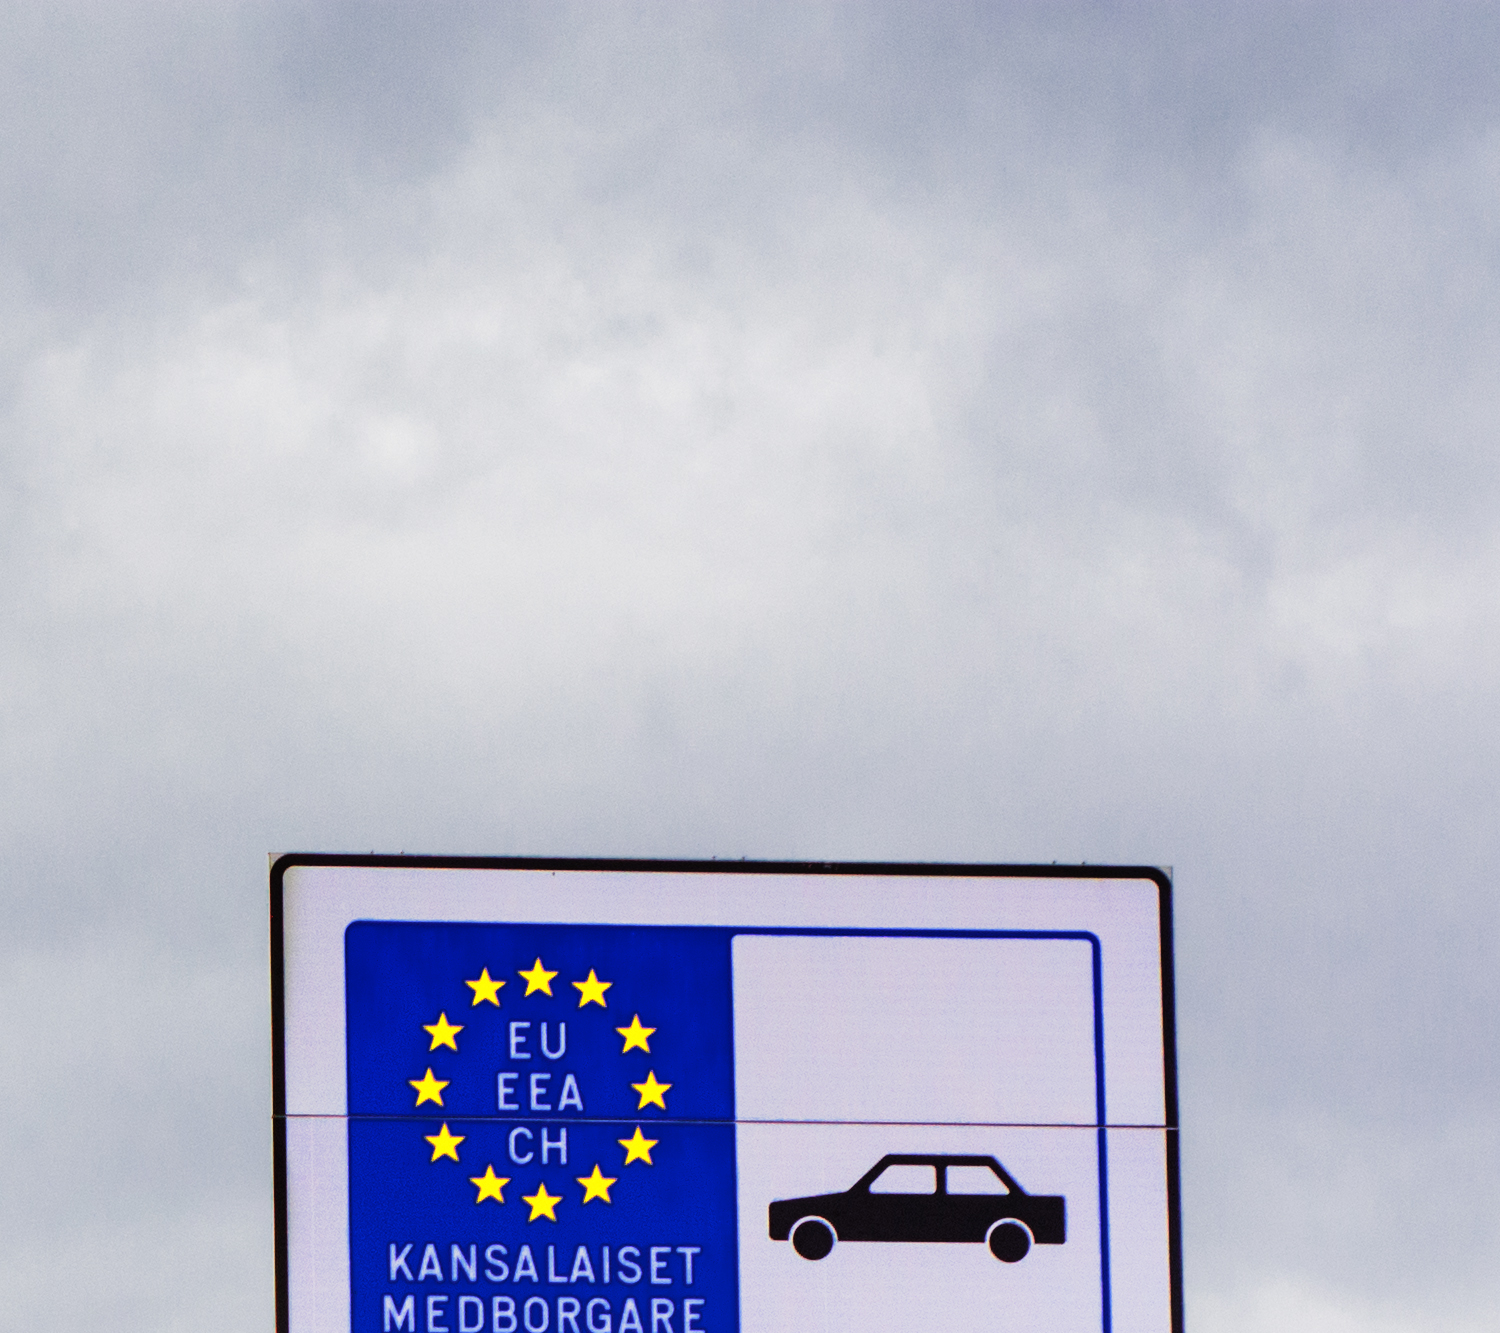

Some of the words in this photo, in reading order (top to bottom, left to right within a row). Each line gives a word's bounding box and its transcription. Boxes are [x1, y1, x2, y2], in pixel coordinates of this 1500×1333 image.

[509, 1021, 566, 1059] EU
[498, 1072, 583, 1110] EEA
[509, 1126, 567, 1164] CH
[390, 1243, 701, 1284] KANSALAISET
